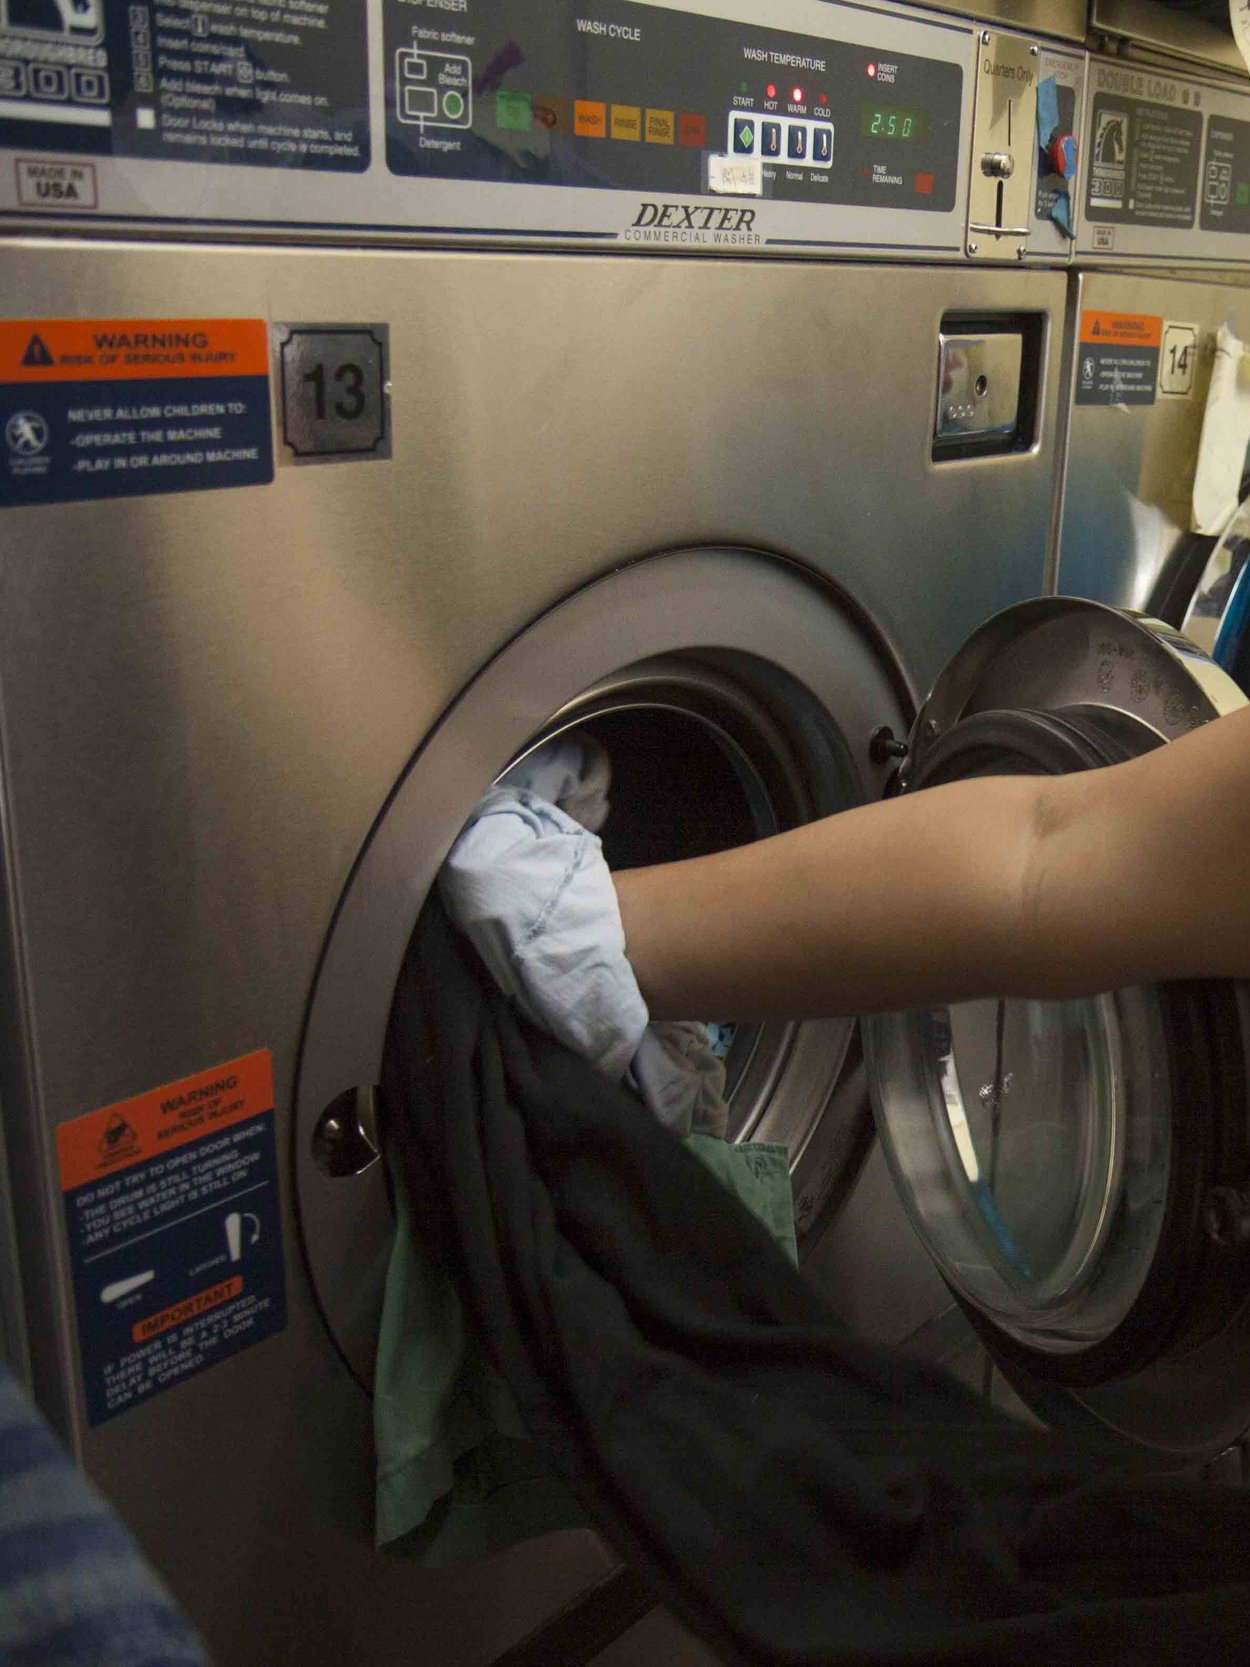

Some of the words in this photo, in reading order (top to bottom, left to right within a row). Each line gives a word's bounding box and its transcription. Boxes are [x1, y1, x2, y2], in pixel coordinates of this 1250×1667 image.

[411, 26, 440, 39] Fabric
[441, 32, 475, 46] softener
[577, 18, 607, 36] WASH
[609, 25, 641, 41] CYCLE
[444, 63, 462, 75] Add
[743, 47, 768, 63] WASH
[770, 51, 826, 72] TEMPERATURE
[877, 63, 898, 75] INSERT
[438, 73, 467, 87] Bleach
[877, 72, 895, 84] COINS
[984, 58, 1015, 80] Quarters
[1016, 65, 1033, 87] Only
[732, 95, 754, 108] START
[763, 100, 778, 111] HOT
[787, 103, 807, 115] WARM
[814, 106, 831, 118] COLD
[613, 117, 638, 130] RINSE
[871, 113, 912, 137] 2.50
[419, 137, 461, 152] Detergent
[785, 169, 803, 181] Normal
[872, 174, 903, 185] REMAINING
[873, 164, 887, 175] TIME
[36, 181, 79, 199] USA
[631, 203, 756, 231] DEXTER
[624, 229, 707, 243] COMMERCIAL
[713, 232, 761, 245] WASHER
[93, 333, 209, 350] WARNING
[59, 353, 94, 366] RISK
[98, 353, 118, 365] OF
[124, 351, 185, 365] SERIOUS
[189, 350, 237, 363] INJURY
[1169, 344, 1190, 377] 14
[303, 362, 367, 421] 13
[67, 406, 115, 423] NEVER
[116, 405, 162, 421] ALLOW
[163, 403, 225, 419] CHILDREN
[140, 430, 165, 443] THE
[166, 427, 223, 442] MACHINE
[113, 457, 128, 470] IN
[129, 455, 149, 469] OR
[150, 451, 204, 467] AROUND
[205, 447, 260, 463] MACHINE
[160, 1074, 239, 1115] WARNING
[76, 1191, 95, 1208] DO
[97, 1180, 121, 1199] NOT
[124, 1172, 146, 1188] TRY
[150, 1163, 165, 1177] TO
[166, 1151, 198, 1171] OPEN
[199, 1136, 231, 1156] DOOR
[109, 1188, 144, 1210] DRUM
[145, 1183, 158, 1196] IS
[159, 1171, 190, 1190] STILL
[191, 1149, 240, 1175] TURNING
[112, 1205, 136, 1222] SEE
[137, 1187, 177, 1211] WATER
[178, 1179, 191, 1192] IN
[192, 1170, 215, 1188] THE
[215, 1150, 261, 1177] WINDOW
[112, 1212, 151, 1235] CYCLE
[151, 1196, 185, 1218] LIGHT
[186, 1191, 200, 1204] IS
[201, 1177, 230, 1197] STILL
[231, 1169, 249, 1184] ON
[142, 1282, 235, 1335] IMPORTANT
[105, 1363, 143, 1386] THERE
[149, 1347, 176, 1365] WILL
[181, 1336, 196, 1351] BE
[200, 1329, 209, 1340] A
[232, 1297, 271, 1324] MINUTE
[120, 1342, 163, 1366] POWER
[167, 1332, 178, 1345] IS
[105, 1375, 144, 1398] DELAY
[148, 1350, 193, 1378] BEFORE
[199, 1337, 219, 1352] THE
[223, 1318, 255, 1339] DOOR
[107, 1391, 133, 1410] CAN
[137, 1380, 153, 1395] BE
